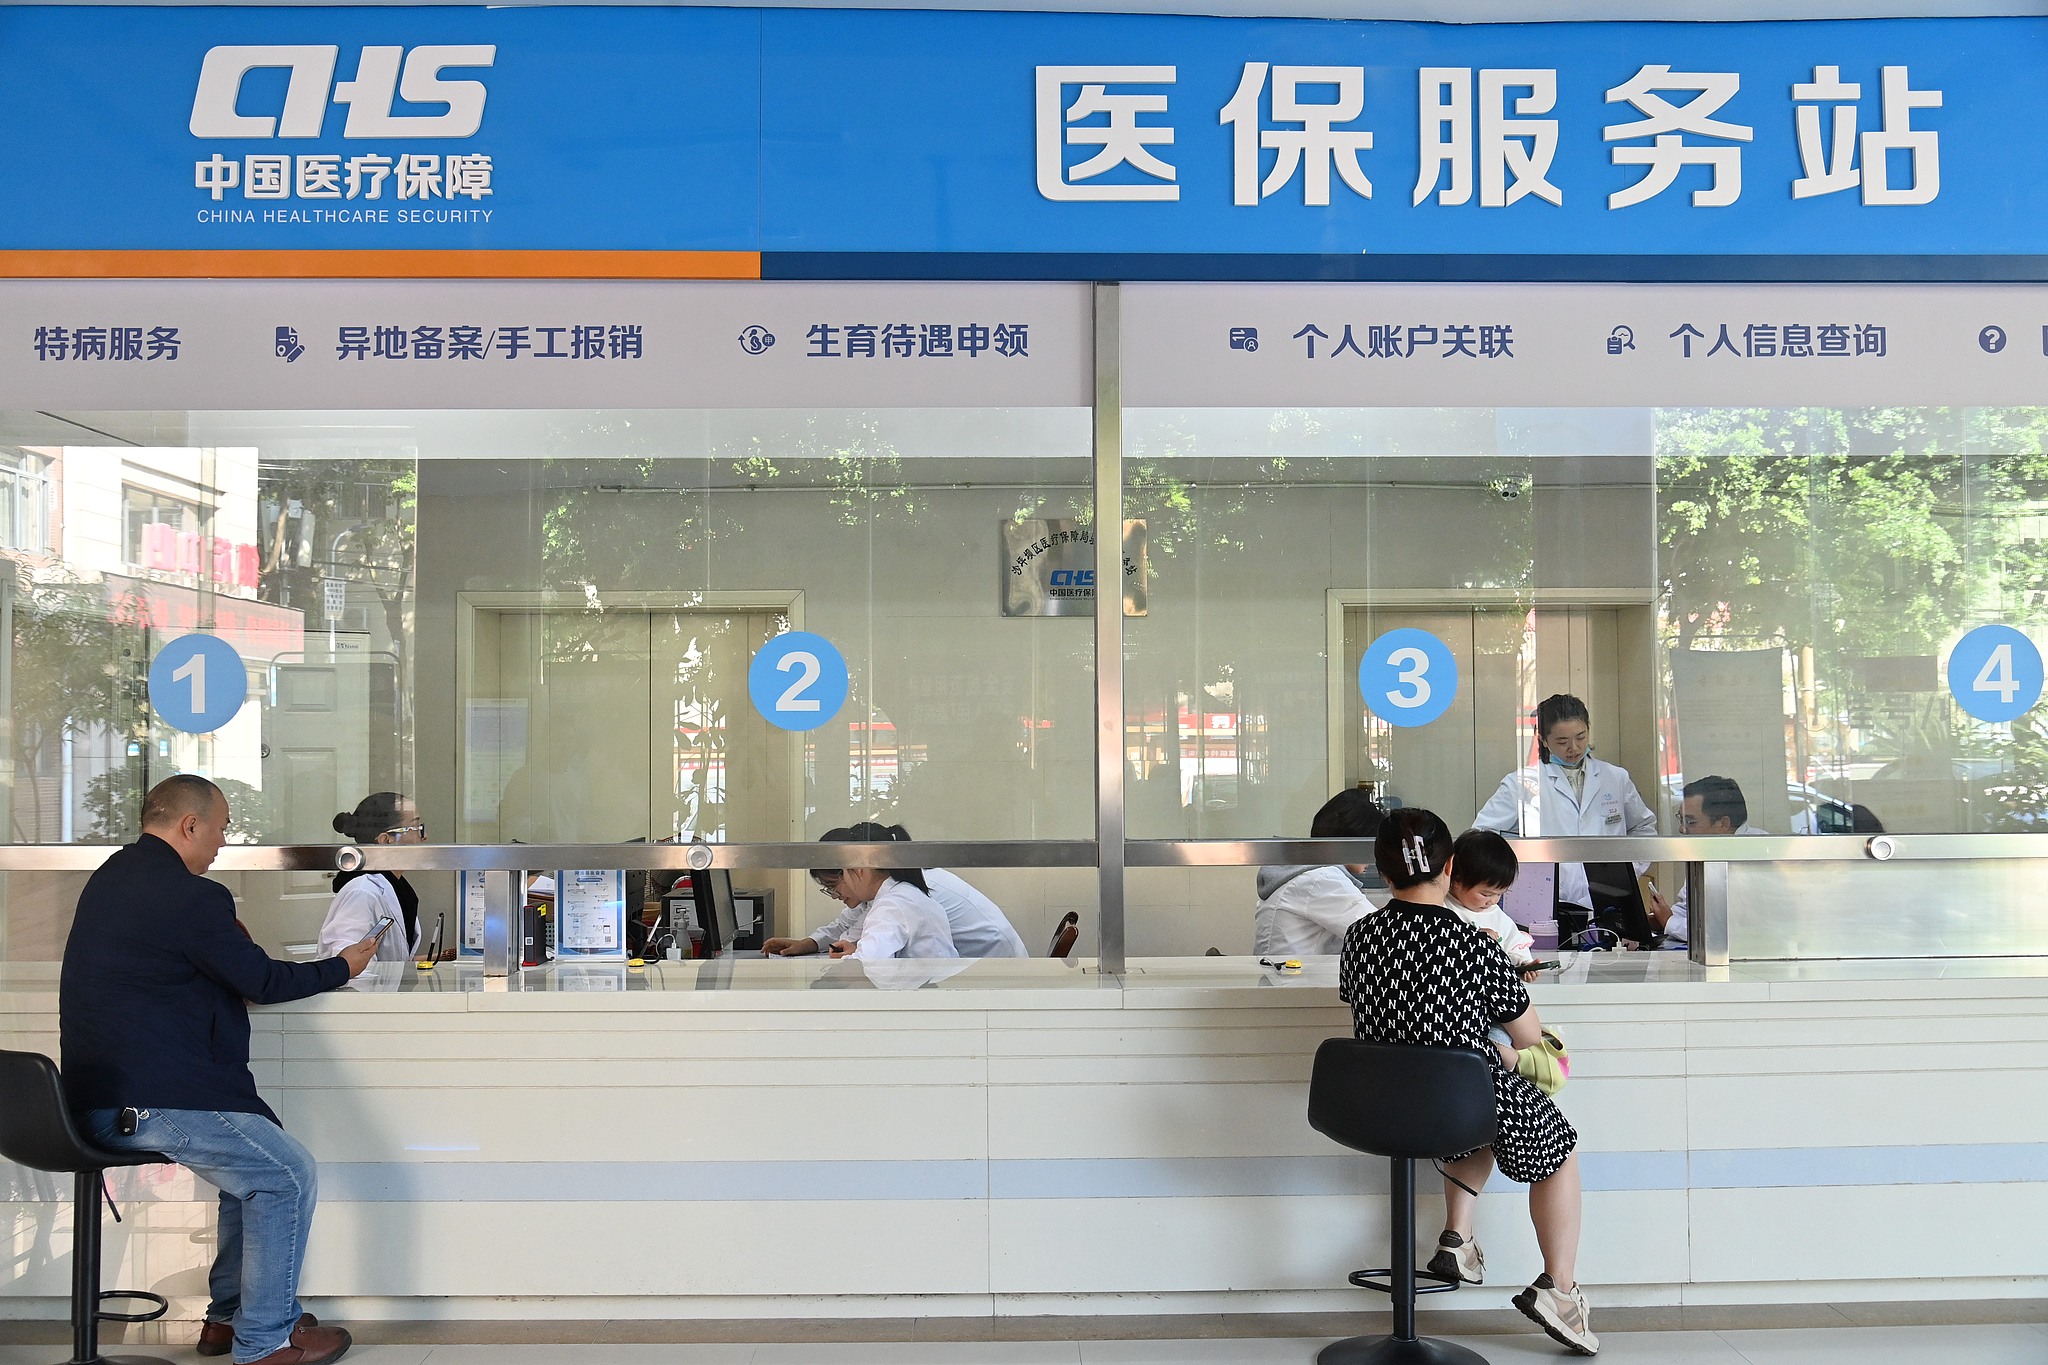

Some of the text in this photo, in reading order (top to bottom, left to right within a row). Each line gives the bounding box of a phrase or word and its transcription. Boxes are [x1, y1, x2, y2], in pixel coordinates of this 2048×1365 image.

[1036, 62, 1943, 210] 医保服务站
[195, 154, 494, 202] 中国医疗保障
[197, 209, 493, 223] CHINA HEALTHCARE SECURITY
[34, 326, 182, 362] 特病服务
[336, 325, 643, 361] 异地备案/手工报销
[806, 323, 1029, 359] 生育待遇申领
[1293, 324, 1514, 359] 个人账户关联
[1670, 324, 1887, 358] 个人信息查询
[172, 654, 206, 714] 1
[776, 651, 821, 712] 2
[1386, 648, 1432, 708] 3
[1973, 644, 2020, 704] 4
